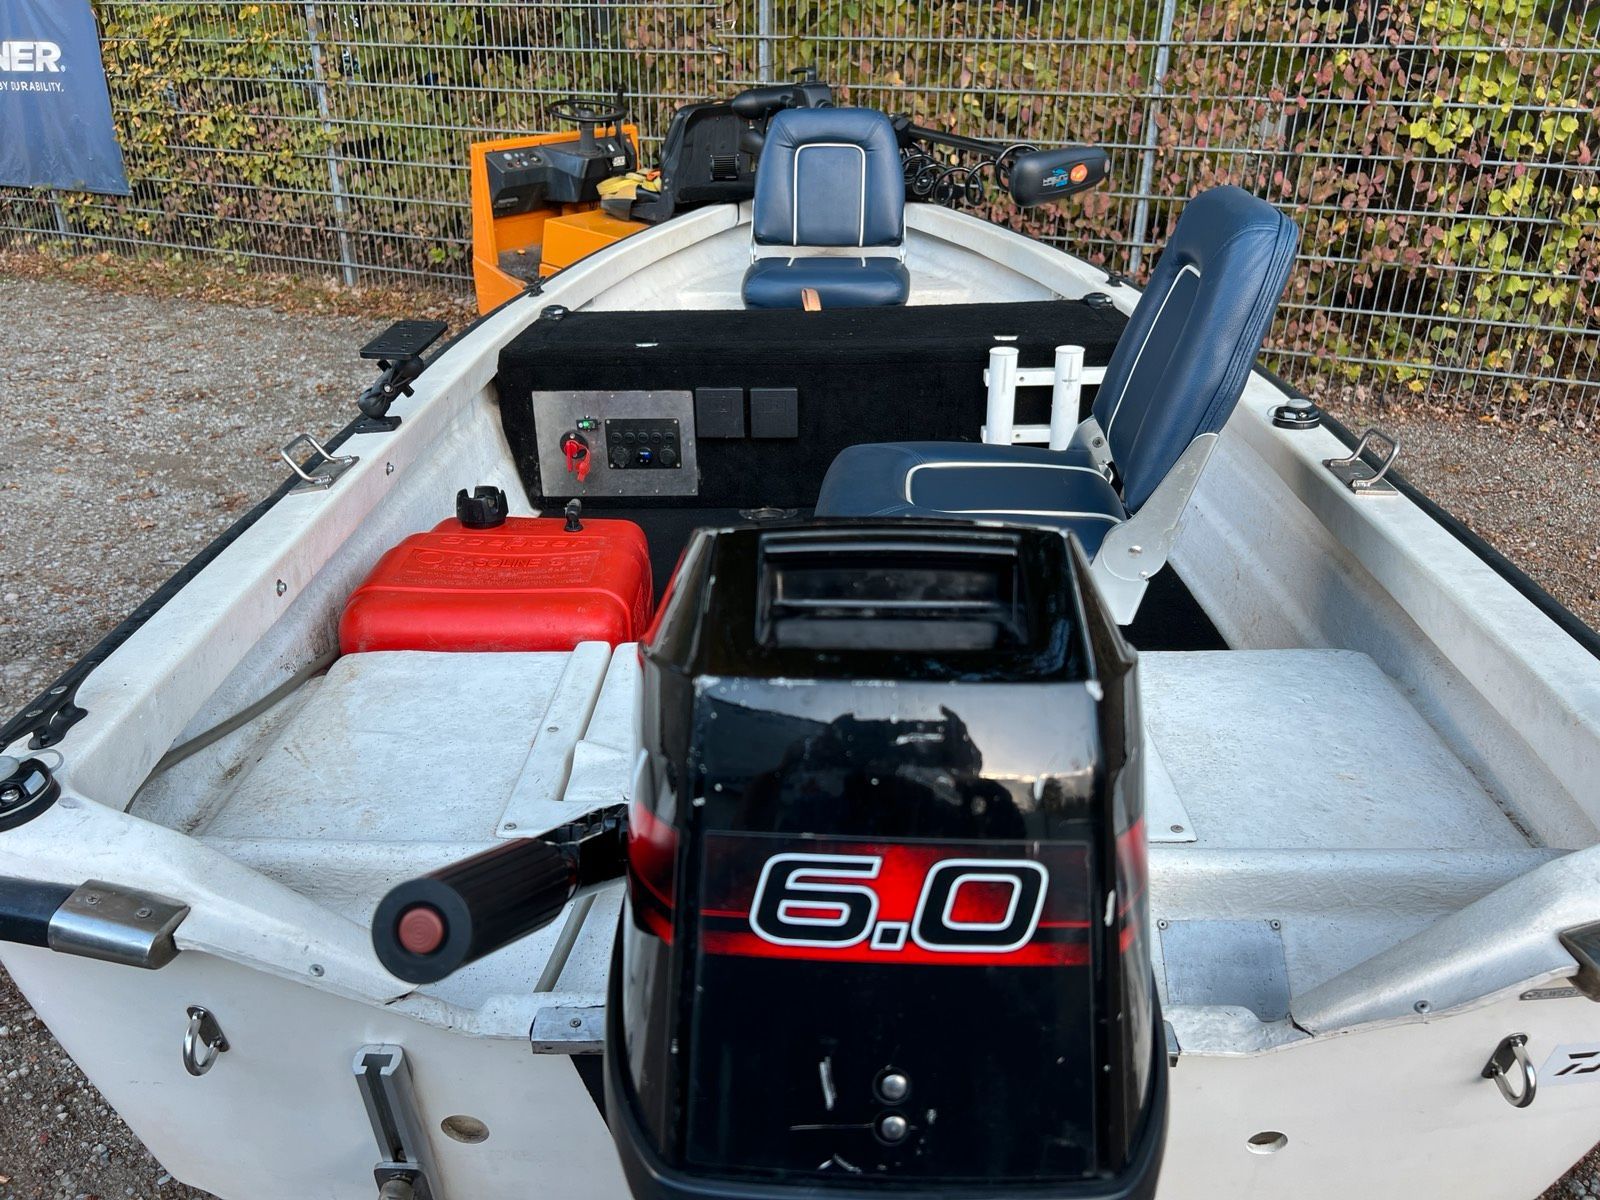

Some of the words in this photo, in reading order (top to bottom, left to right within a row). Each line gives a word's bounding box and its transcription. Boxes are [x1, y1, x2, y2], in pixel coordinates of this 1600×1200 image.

[11, 81, 64, 92] DURABILITY.
[453, 557, 541, 568] GASOLINE
[749, 852, 1050, 953] 6.0
